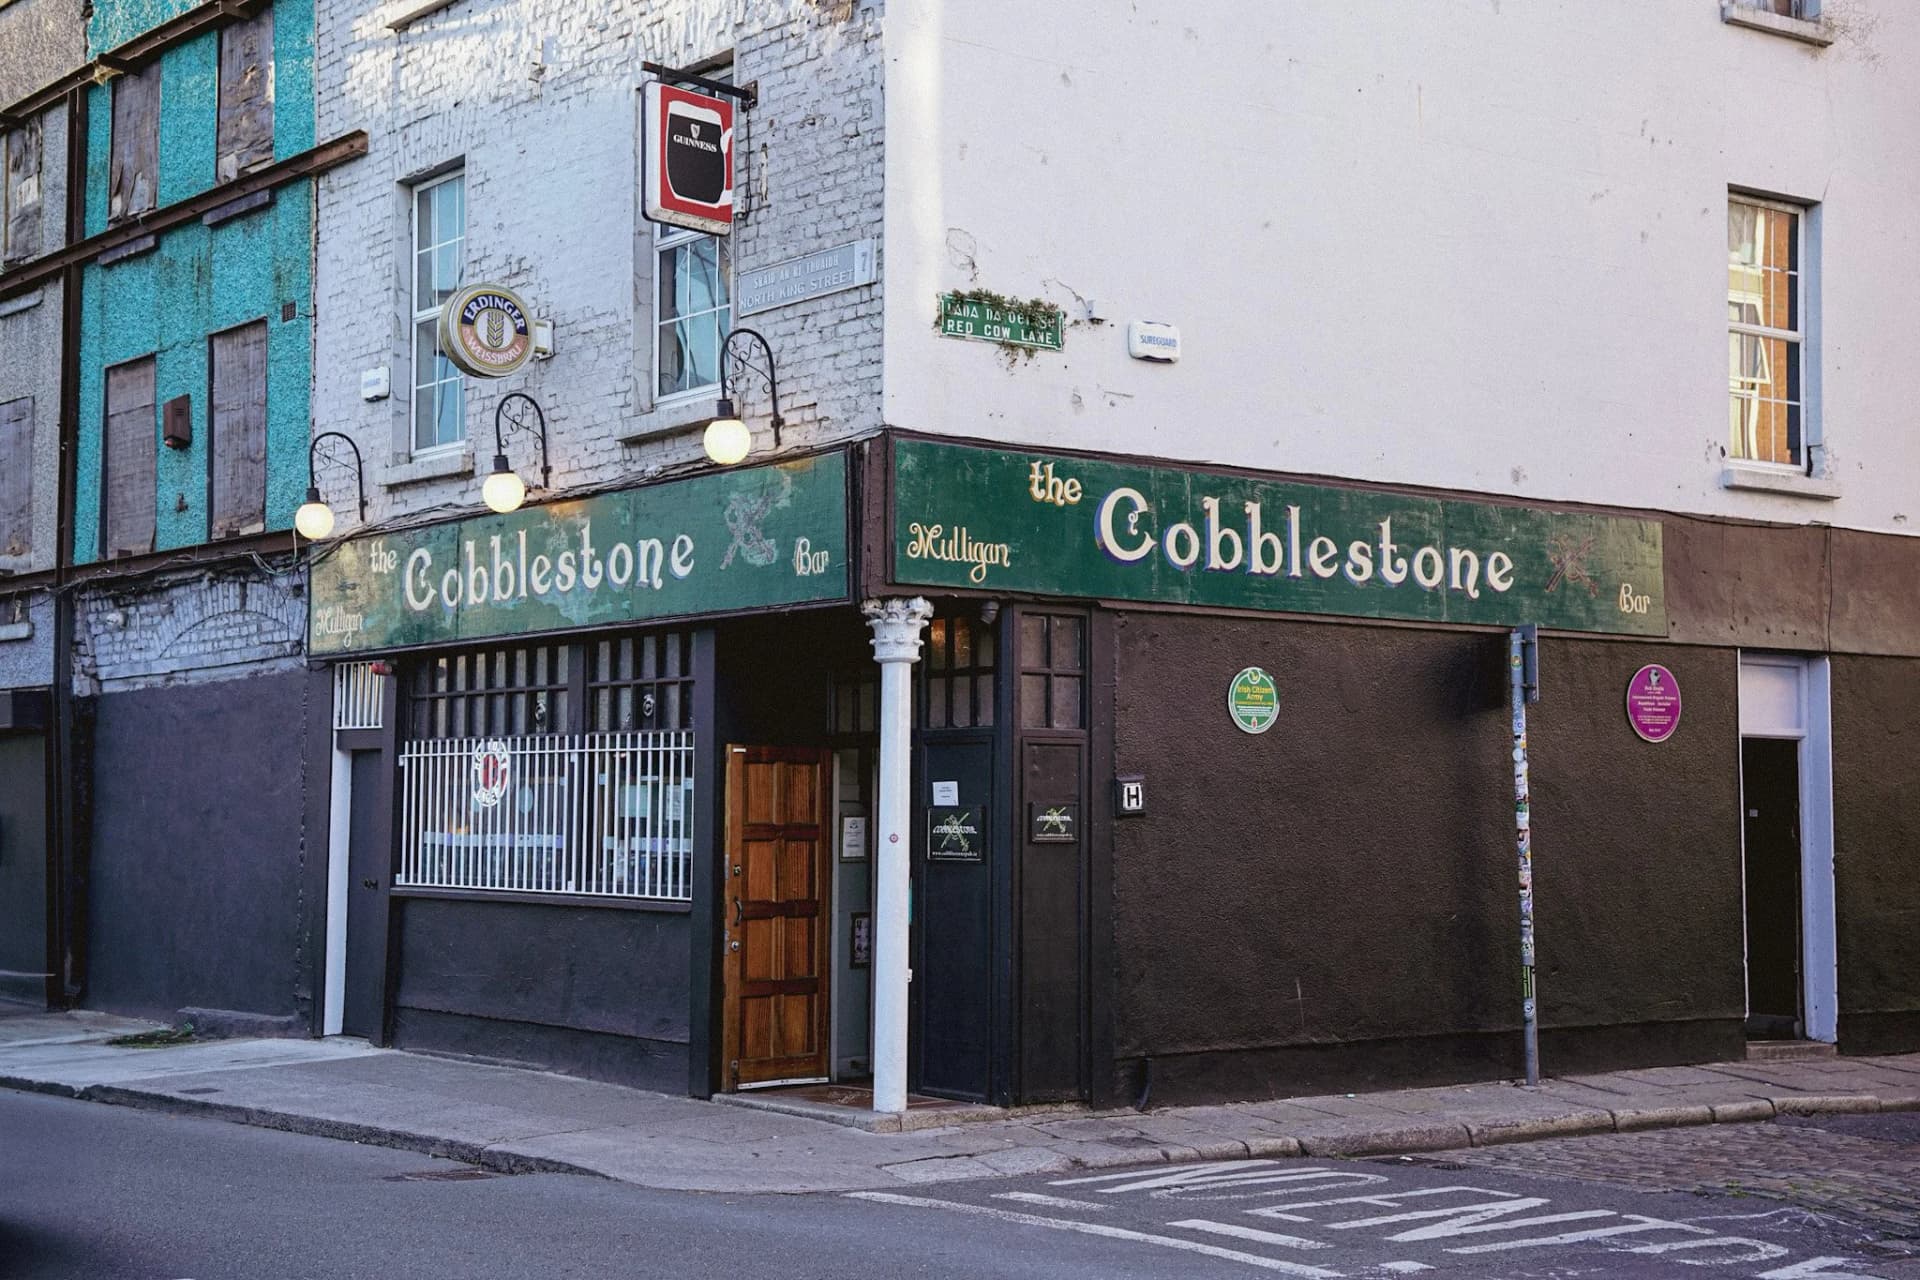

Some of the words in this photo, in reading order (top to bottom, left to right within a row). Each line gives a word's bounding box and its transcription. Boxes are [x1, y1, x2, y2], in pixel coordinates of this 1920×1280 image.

[673, 134, 718, 153] GUINNESS
[861, 251, 869, 272] 7
[740, 291, 775, 309] NORTH
[779, 283, 806, 299] KING
[810, 269, 855, 292] STREET
[463, 295, 526, 329] ERDINGER
[947, 319, 973, 334] RED
[984, 324, 1011, 339] COW
[1029, 460, 1083, 507] the
[1096, 487, 1514, 600] Cobblestone
[369, 540, 397, 574] the
[404, 523, 695, 611] Cobblestone
[794, 537, 829, 576] Bar
[907, 522, 1011, 583] Mulligan
[1619, 583, 1650, 614] Bar
[315, 606, 363, 648] Mulligan
[1127, 786, 1140, 807] H
[1047, 1159, 1390, 1201] NO
